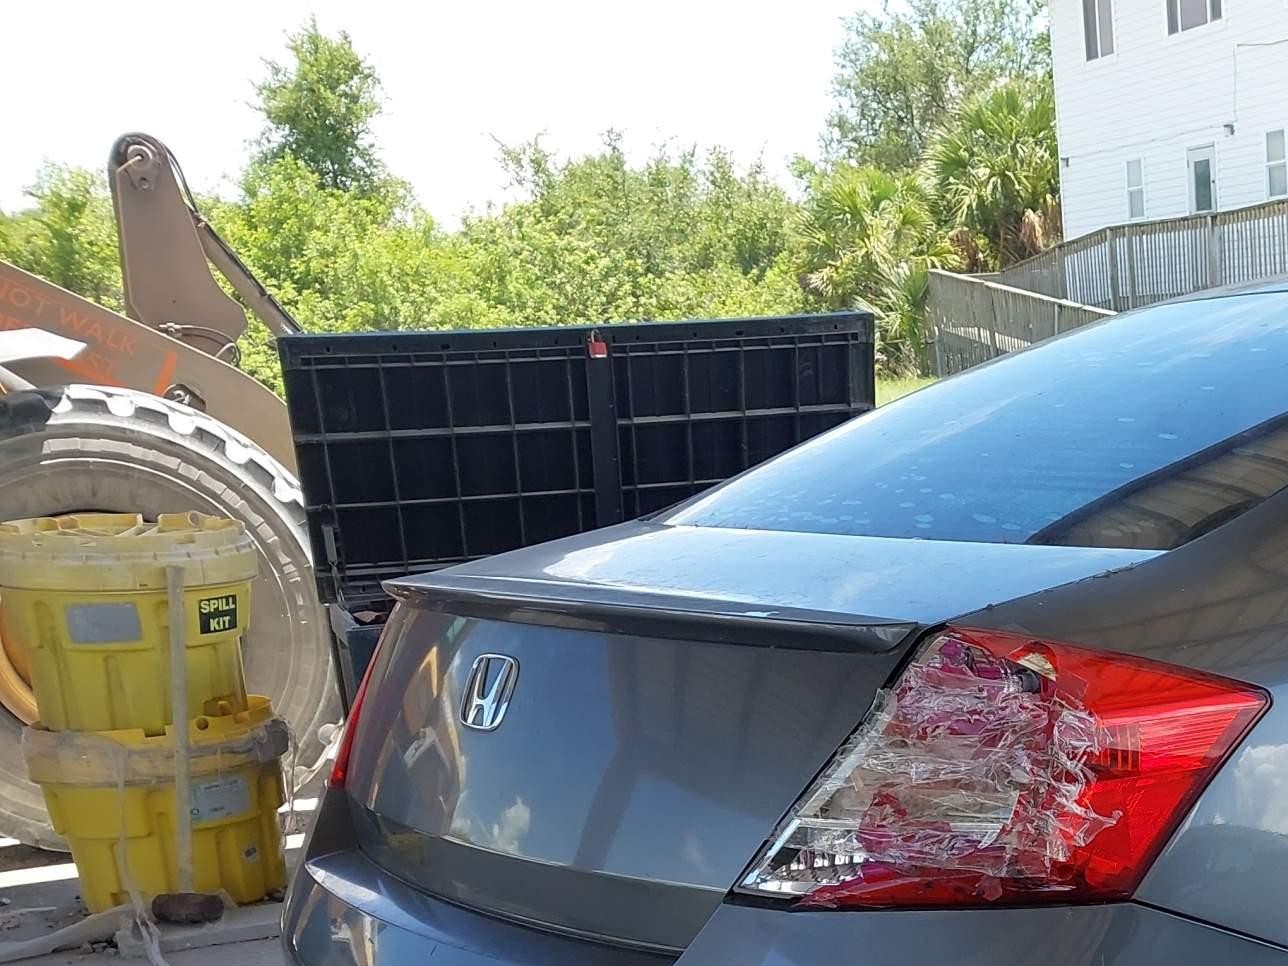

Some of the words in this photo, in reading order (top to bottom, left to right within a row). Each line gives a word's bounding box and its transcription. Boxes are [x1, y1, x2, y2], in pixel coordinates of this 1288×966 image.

[59, 306, 136, 358] WALK
[200, 597, 236, 613] SPILL
[210, 616, 231, 631] KIT
